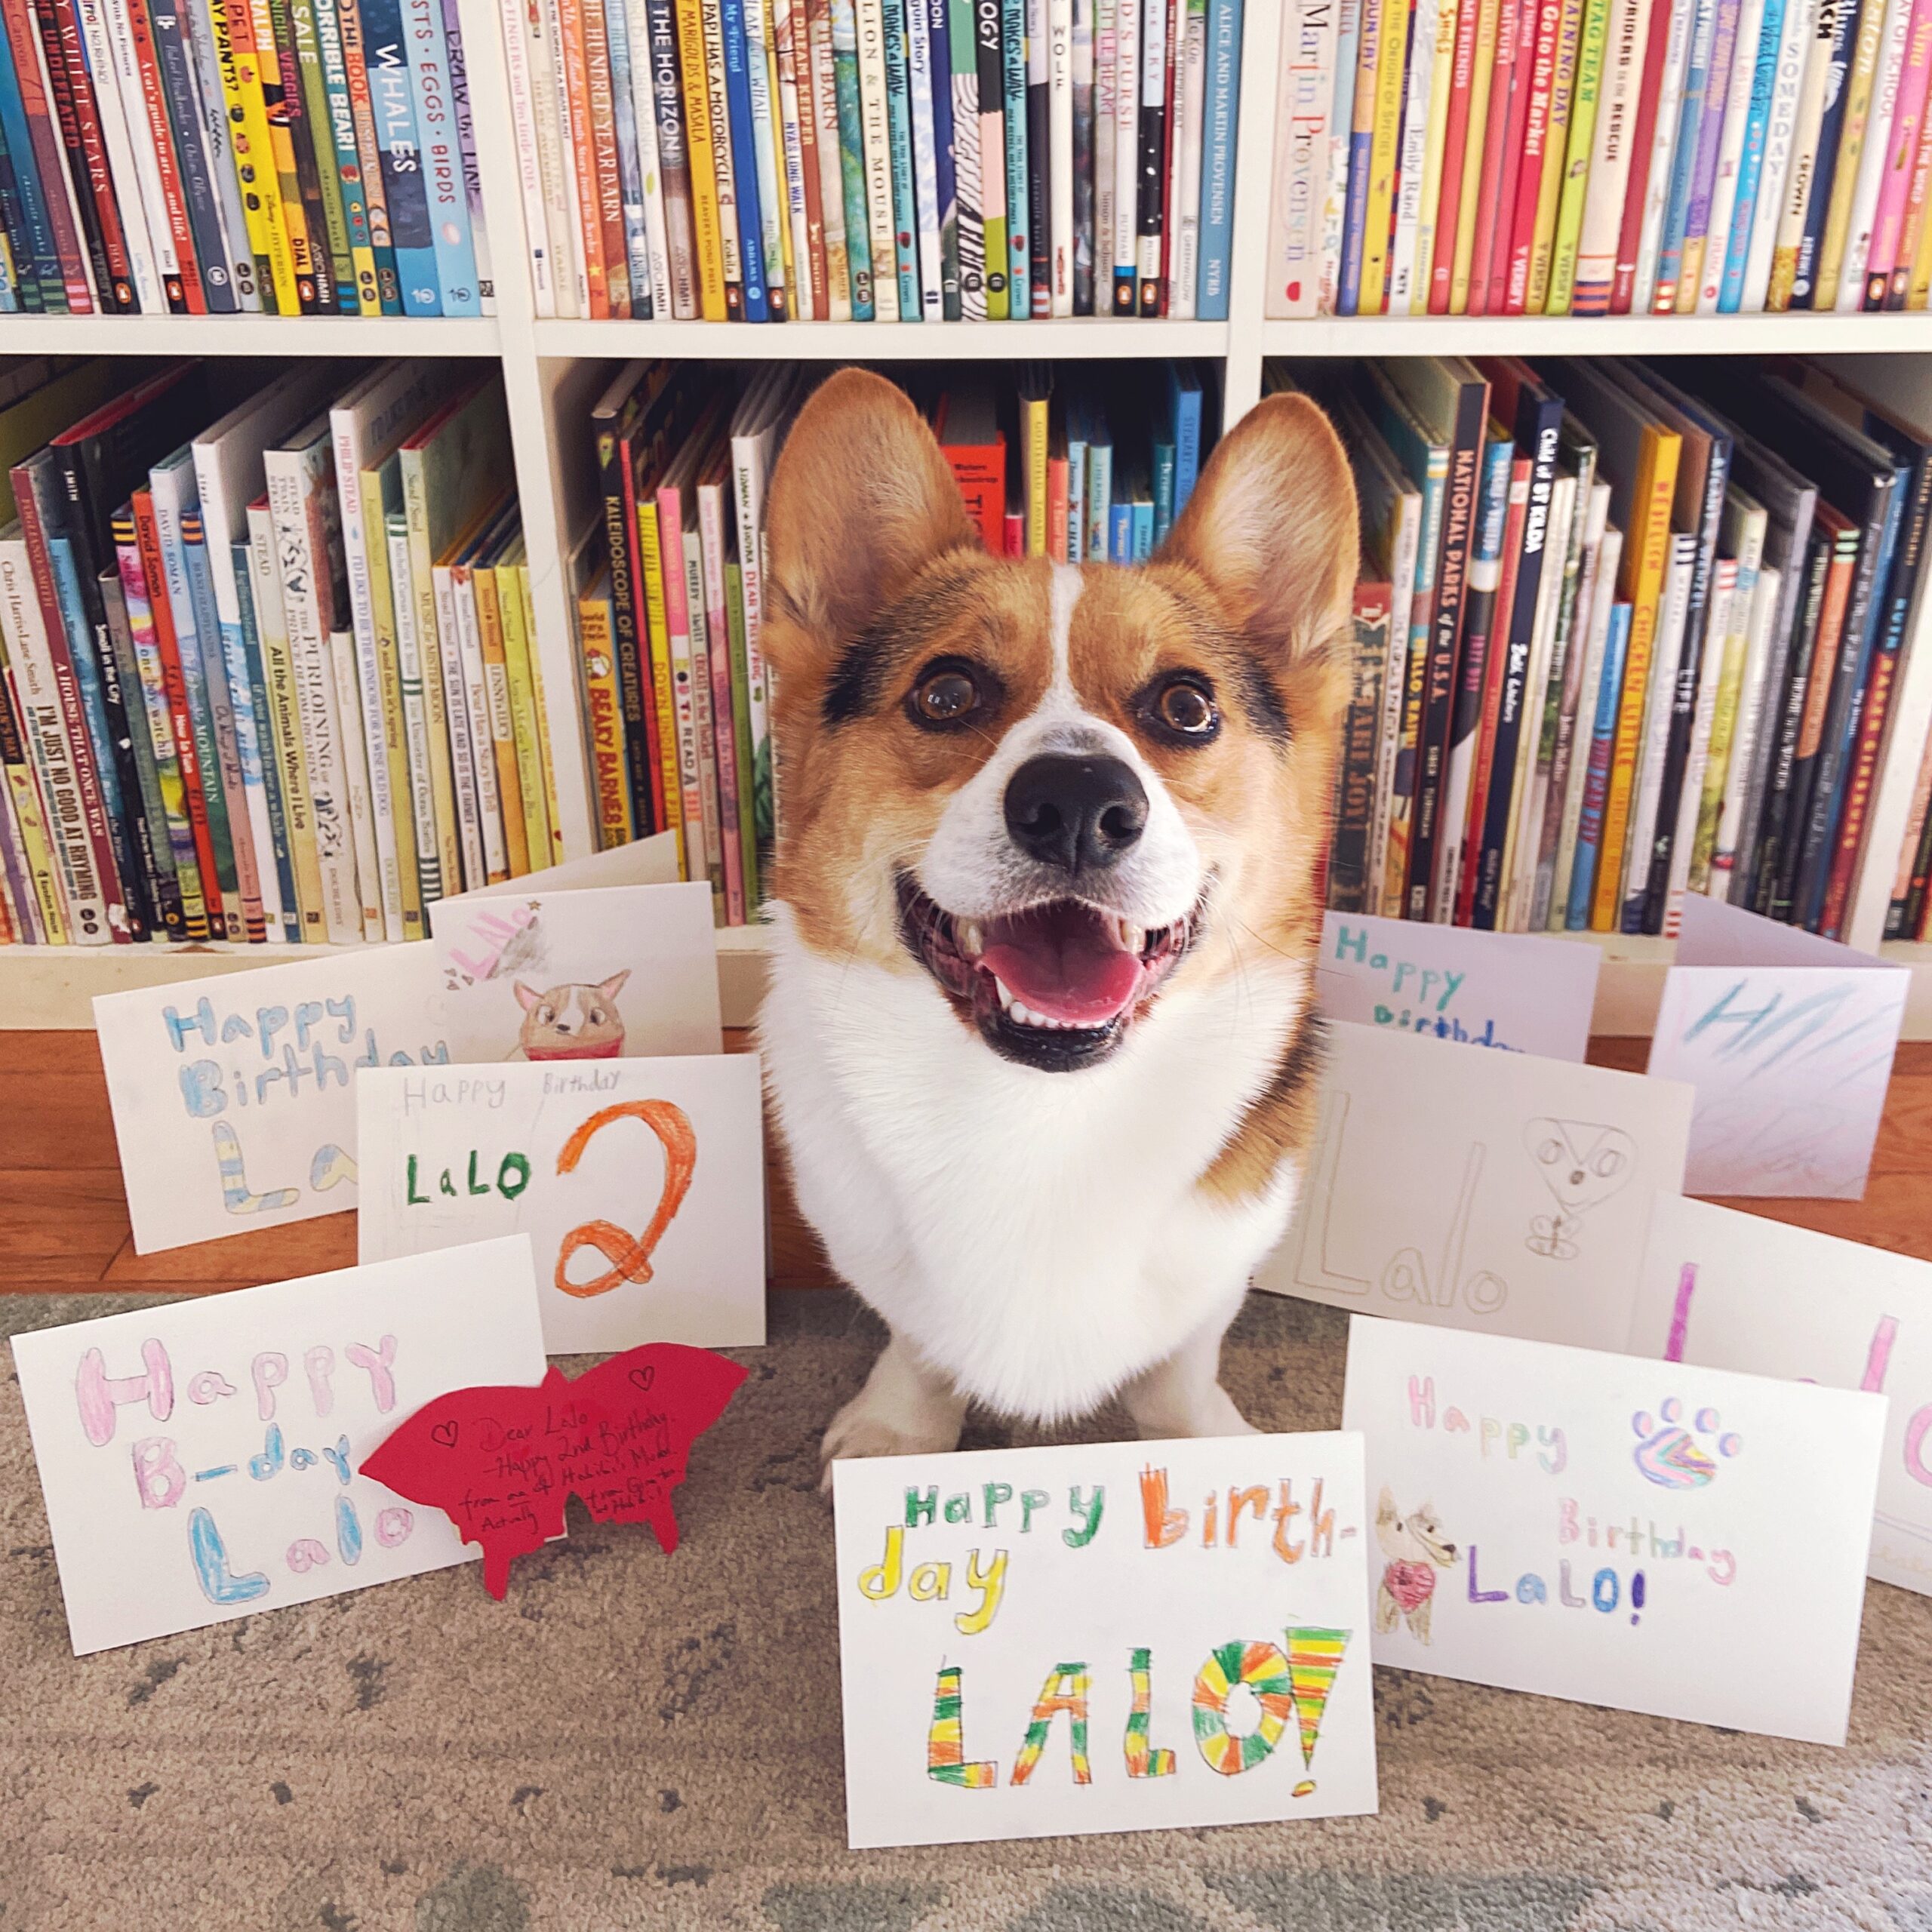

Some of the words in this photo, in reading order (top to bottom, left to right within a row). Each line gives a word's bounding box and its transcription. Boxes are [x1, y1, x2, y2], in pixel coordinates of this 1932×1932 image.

[11, 14, 30, 66] Canyon
[229, 5, 249, 41] PET
[292, 6, 318, 63] SALE
[651, 7, 669, 47] THE
[703, 3, 720, 36] PAPI
[862, 2, 879, 60] LION
[884, 4, 902, 51] MAKES
[980, 2, 999, 50] OGY
[1218, 4, 1232, 47] ALICE
[1497, 4, 1515, 65] MIYUKI
[1543, 6, 1559, 32] Go
[1588, 2, 1604, 39] TAG
[215, 21, 238, 91] PANTS?
[681, 10, 699, 78] MARIGOLDS
[706, 41, 721, 69] HAS
[793, 17, 810, 75] DREAM
[910, 37, 925, 74] Story
[1148, 42, 1160, 80] SKY
[1287, 4, 1331, 104] Martin
[1455, 26, 1472, 88] FRIENDS
[1538, 37, 1554, 54] to
[143, 61, 152, 70] A
[280, 51, 301, 118] VEGGIES
[445, 29, 469, 106] DRAW
[458, 114, 473, 140] the
[709, 77, 722, 86] A
[1217, 51, 1231, 84] AND
[1534, 58, 1549, 87] the
[1580, 48, 1600, 102] TEAM
[375, 43, 417, 172] WHALES
[420, 62, 445, 122] EGGS
[655, 53, 680, 152] HORIZON
[688, 82, 699, 93] &
[1100, 63, 1115, 118] HEART
[147, 102, 165, 140] guide
[688, 97, 706, 143] MASALA
[798, 84, 814, 146] KEEPER
[868, 100, 882, 145] THE
[1214, 88, 1229, 141] MARTIN
[1525, 91, 1549, 156] Market
[1605, 103, 1625, 163] RESCUE
[80, 121, 109, 193] STARS
[157, 141, 168, 155] to
[596, 121, 617, 168] YEAR
[709, 91, 731, 187] MOTORCYCLE
[1404, 128, 1424, 172] Emily
[159, 156, 172, 175] art
[431, 145, 455, 204] BIRDS
[788, 155, 801, 183] LONG
[1210, 145, 1226, 226] PROVENSEN
[1790, 154, 1811, 215] CROWN
[168, 192, 181, 215] and
[600, 174, 620, 222] BARN
[789, 186, 804, 214] WALK
[871, 158, 888, 235] MOUSE
[1284, 115, 1325, 261] Provensen
[1401, 181, 1418, 220] Rand
[173, 217, 188, 241] life!
[1119, 214, 1128, 259] PUTNAM
[292, 238, 309, 266] DIAL
[315, 274, 331, 303] HMH
[655, 283, 667, 312] HMH
[678, 278, 691, 307] HMH
[1207, 259, 1220, 296] NYRB
[1396, 267, 1409, 295] TATE
[1509, 259, 1527, 306] VERSIFY
[1531, 255, 1547, 301] VERSIFY
[1555, 255, 1571, 301] VERSIFY
[339, 435, 354, 473] PHILIP
[1537, 429, 1558, 463] Child
[63, 470, 79, 501] SMITH
[1531, 483, 1550, 503] ST
[1537, 466, 1553, 478] of
[342, 475, 357, 515] STEAD
[1447, 449, 1475, 546] NATIONAL
[139, 515, 155, 552] David
[1524, 506, 1547, 554] KILDA
[604, 496, 633, 611] KALEIDOSCOPE
[355, 572, 368, 598] LIKE
[1440, 549, 1463, 608] PARKS
[2, 561, 21, 594] Chris
[26, 663, 42, 695] Smith
[358, 600, 371, 617] TO
[359, 619, 372, 633] BE
[617, 616, 635, 638] OF
[1438, 614, 1454, 626] of
[95, 624, 113, 652] Small
[269, 647, 288, 666] All
[361, 636, 374, 658] THE
[420, 591, 433, 629] MUSIC
[430, 688, 444, 724] MOON
[103, 666, 118, 682] the
[273, 669, 291, 690] the
[382, 651, 393, 671] and
[620, 642, 641, 722] CREATURES
[61, 679, 81, 725] HOUSE
[106, 685, 121, 705] City
[489, 664, 509, 702] LENNY
[36, 705, 55, 726] I'M
[276, 693, 296, 747] Animals
[386, 715, 398, 749] spring
[494, 708, 511, 740] LUCY
[587, 687, 614, 748] BEAKY
[42, 731, 65, 764] JUST
[71, 728, 88, 764] THAT
[456, 733, 470, 749] AND
[681, 727, 694, 769] READ
[52, 767, 70, 785] NO
[196, 724, 220, 804] MOUNTAIN
[285, 751, 303, 793] Where
[376, 769, 386, 792] OLD
[684, 773, 700, 786] A
[54, 789, 80, 823] GOOD
[80, 768, 98, 806] ONCE
[377, 793, 389, 817] DOG
[598, 752, 623, 824] BARNES
[65, 827, 81, 842] AT
[88, 808, 103, 836] WAS
[292, 804, 306, 830] Live
[69, 845, 97, 900] RHYMING
[1335, 926, 1466, 1012] Happy
[162, 992, 358, 1055] Happy
[403, 1077, 509, 1118] Happy
[542, 1069, 623, 1096] Birthday
[553, 1097, 697, 1298] 2
[1294, 1090, 1508, 1316] Lalo
[473, 1417, 532, 1453] Dear
[544, 1404, 589, 1435] Lalo
[1407, 1374, 1568, 1475] Happy
[905, 1480, 1105, 1548] Happy
[187, 1494, 414, 1605] Lalo
[1558, 1497, 1737, 1587] Birthday
[857, 1524, 1010, 1635] day
[926, 1626, 1353, 1798] LALO!
